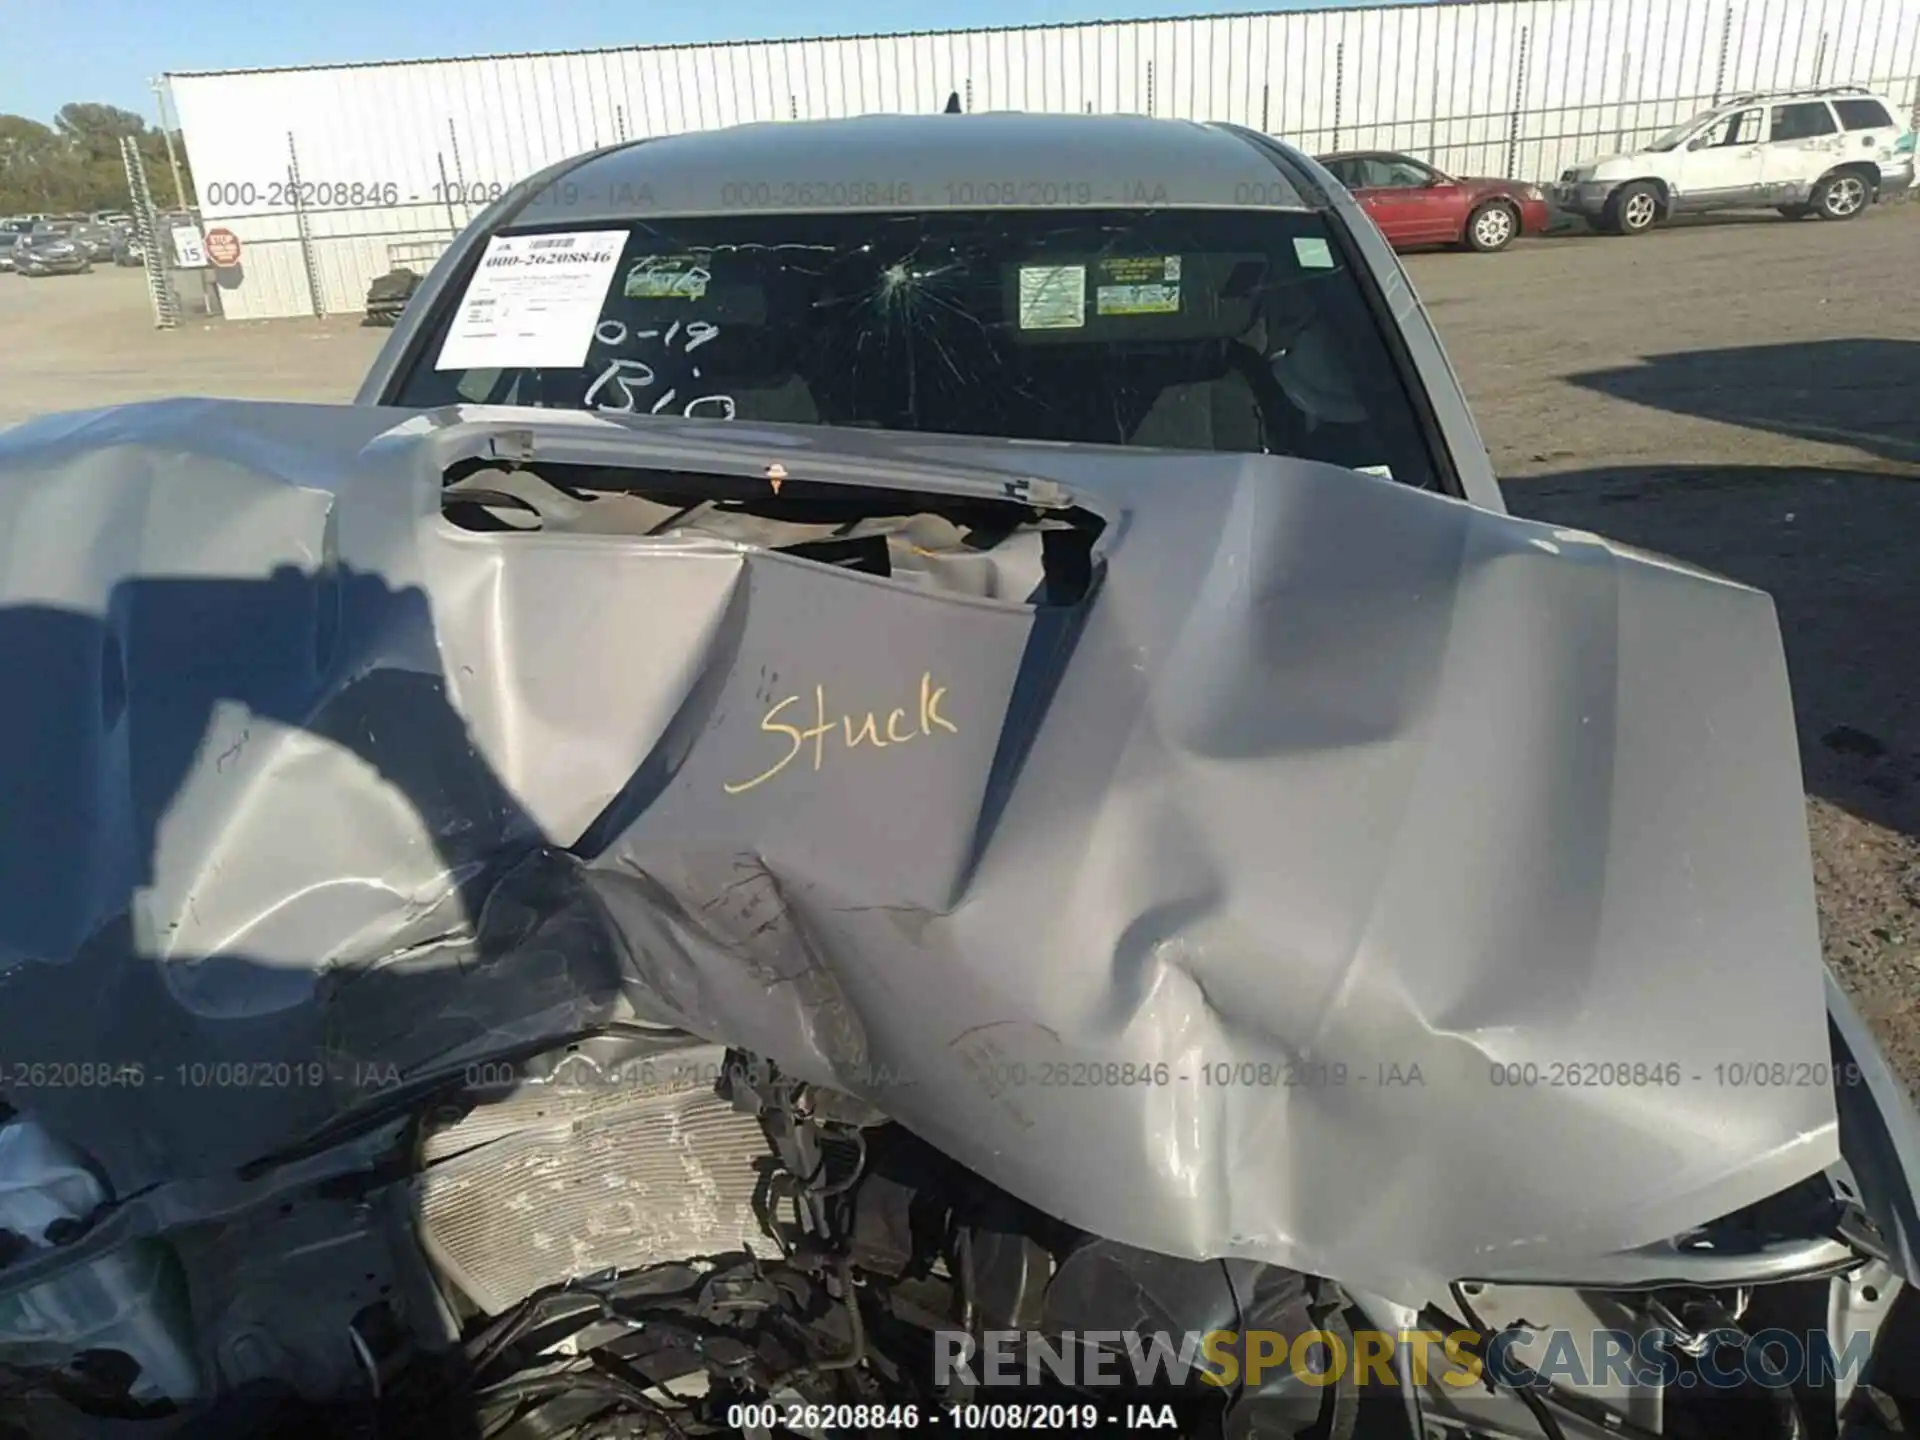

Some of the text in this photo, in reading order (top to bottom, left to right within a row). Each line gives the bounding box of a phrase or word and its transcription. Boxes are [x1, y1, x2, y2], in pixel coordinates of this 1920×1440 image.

[183, 248, 200, 262] 15
[486, 250, 612, 268] 000-26208846
[723, 671, 958, 793] Stuck
